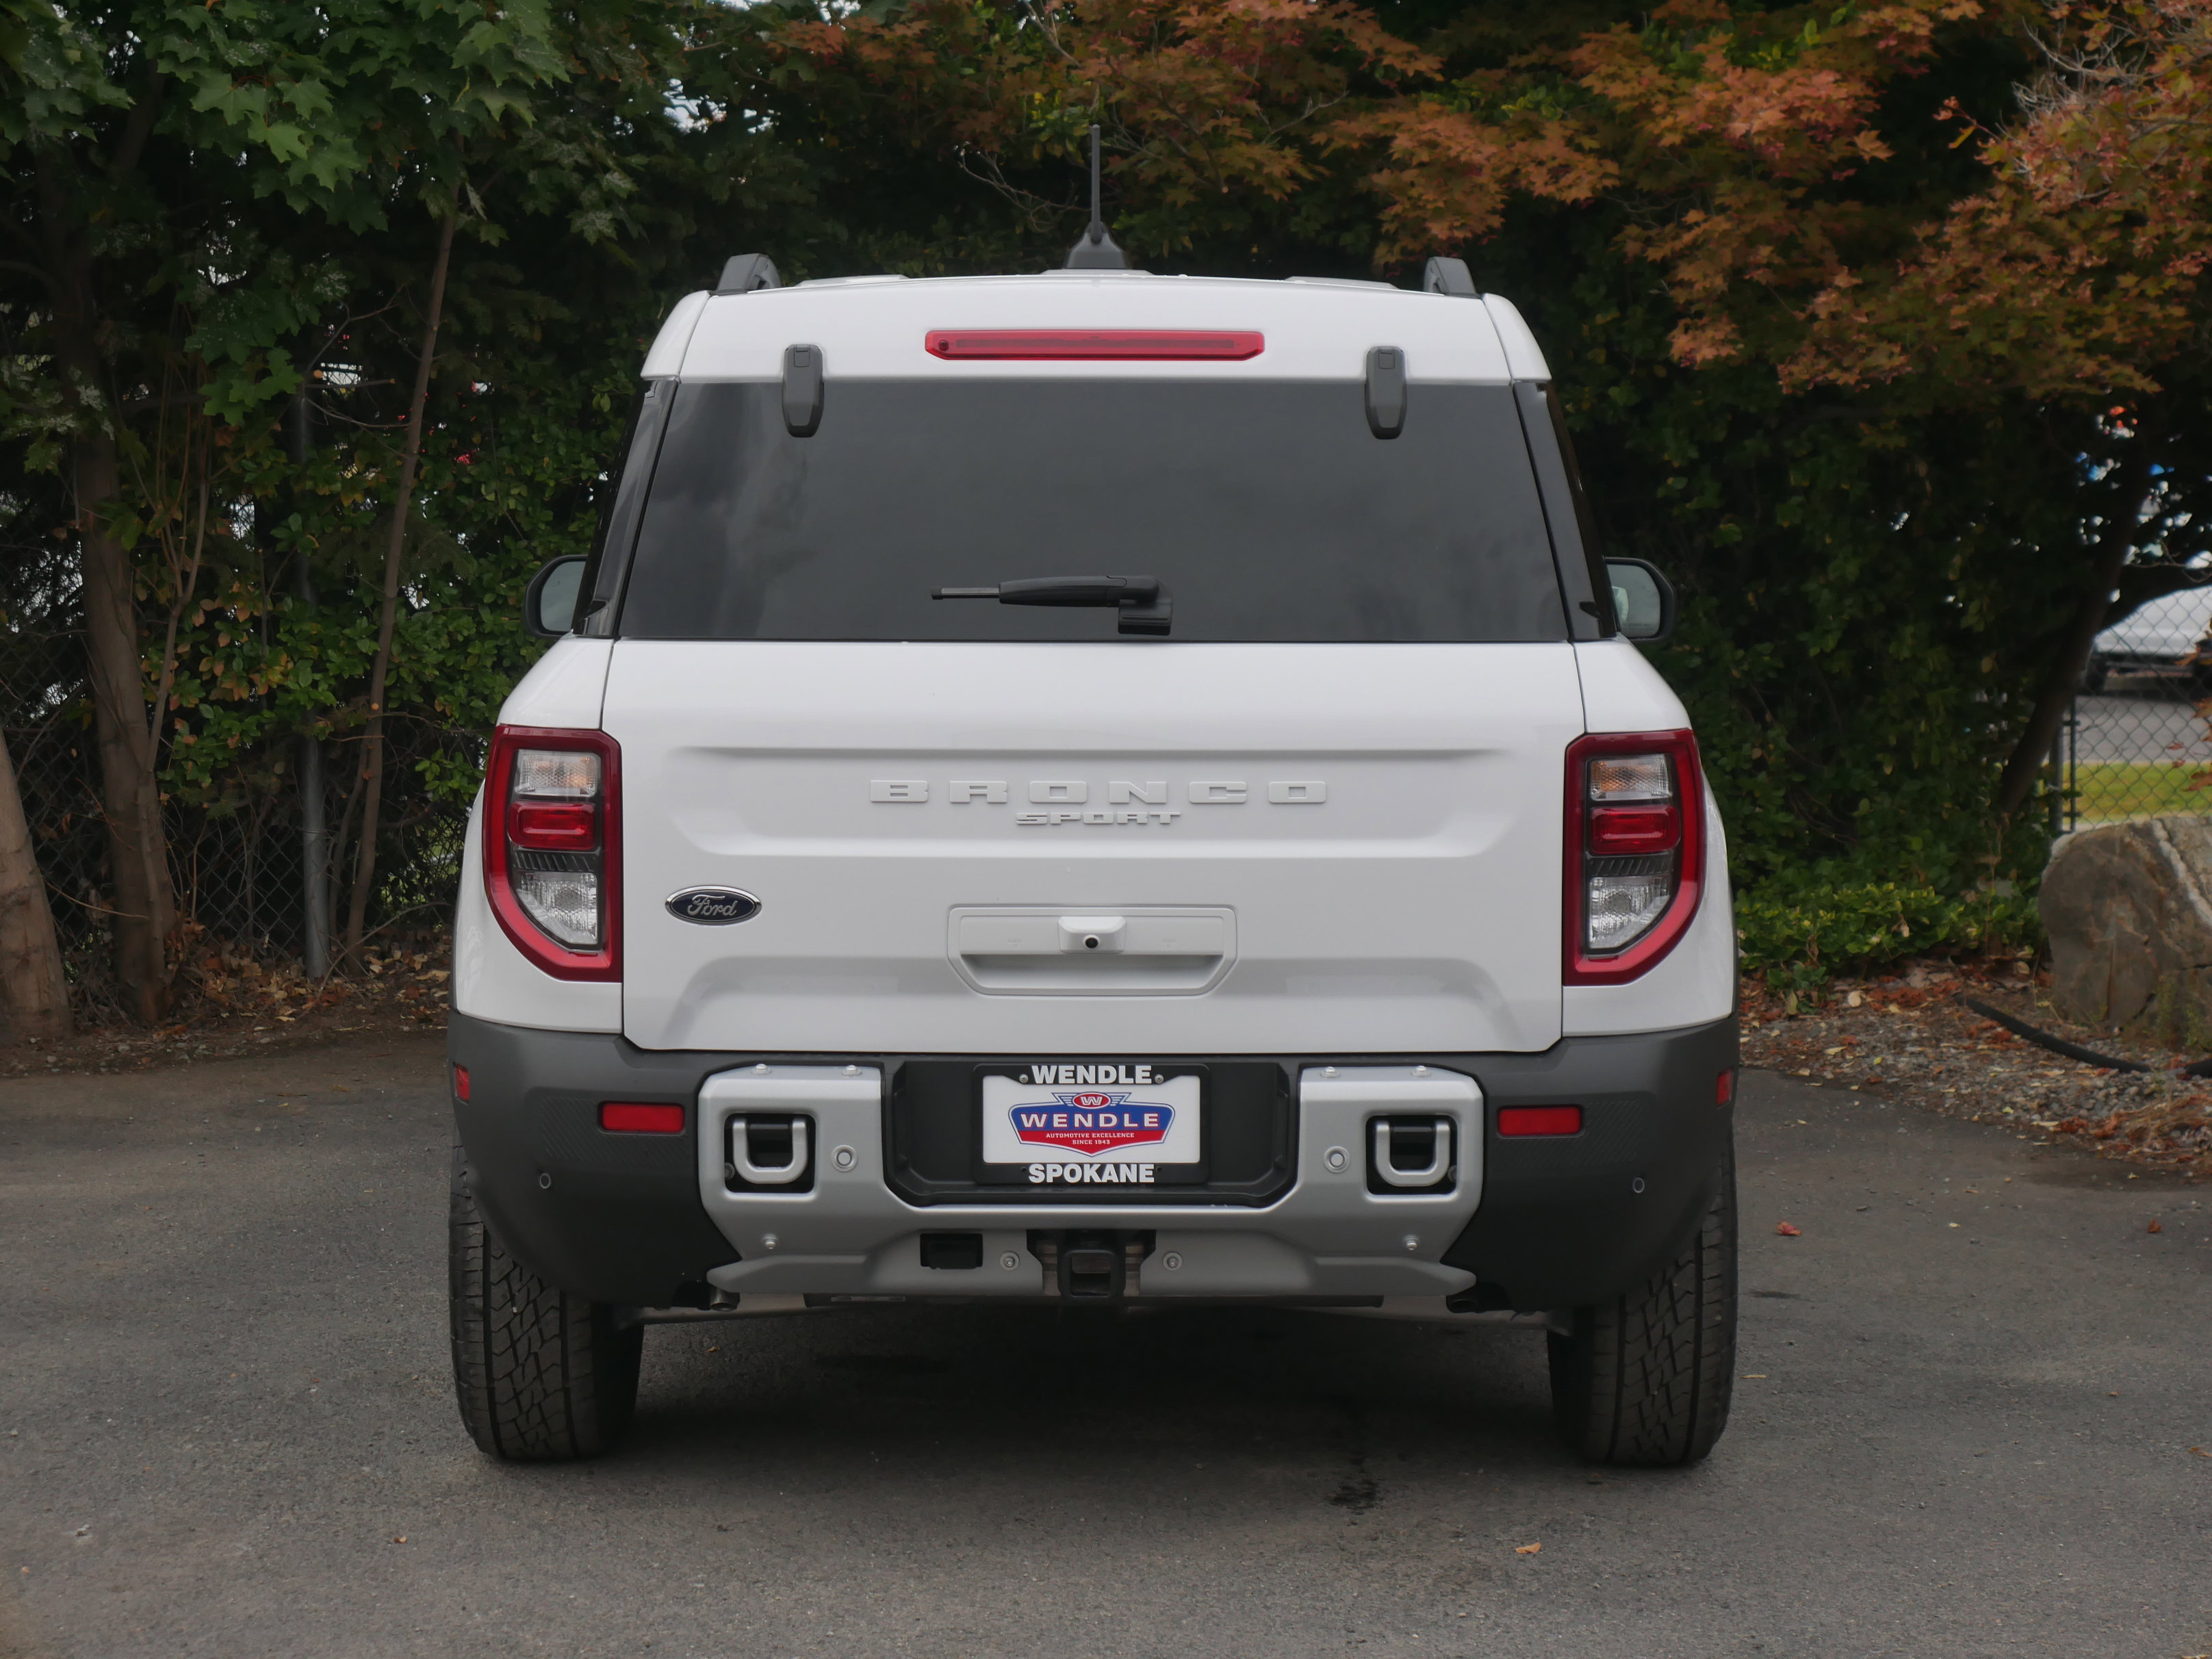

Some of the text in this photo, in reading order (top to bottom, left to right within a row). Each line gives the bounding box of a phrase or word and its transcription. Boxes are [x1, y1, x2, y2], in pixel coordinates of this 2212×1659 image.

[870, 780, 1326, 804] BRONCO
[1016, 812, 1181, 825] SPORT
[687, 894, 738, 916] Ford
[1031, 1065, 1152, 1084] WENDLE
[1020, 1113, 1160, 1128] WENDLE
[1029, 1163, 1155, 1183] SPOKANE
